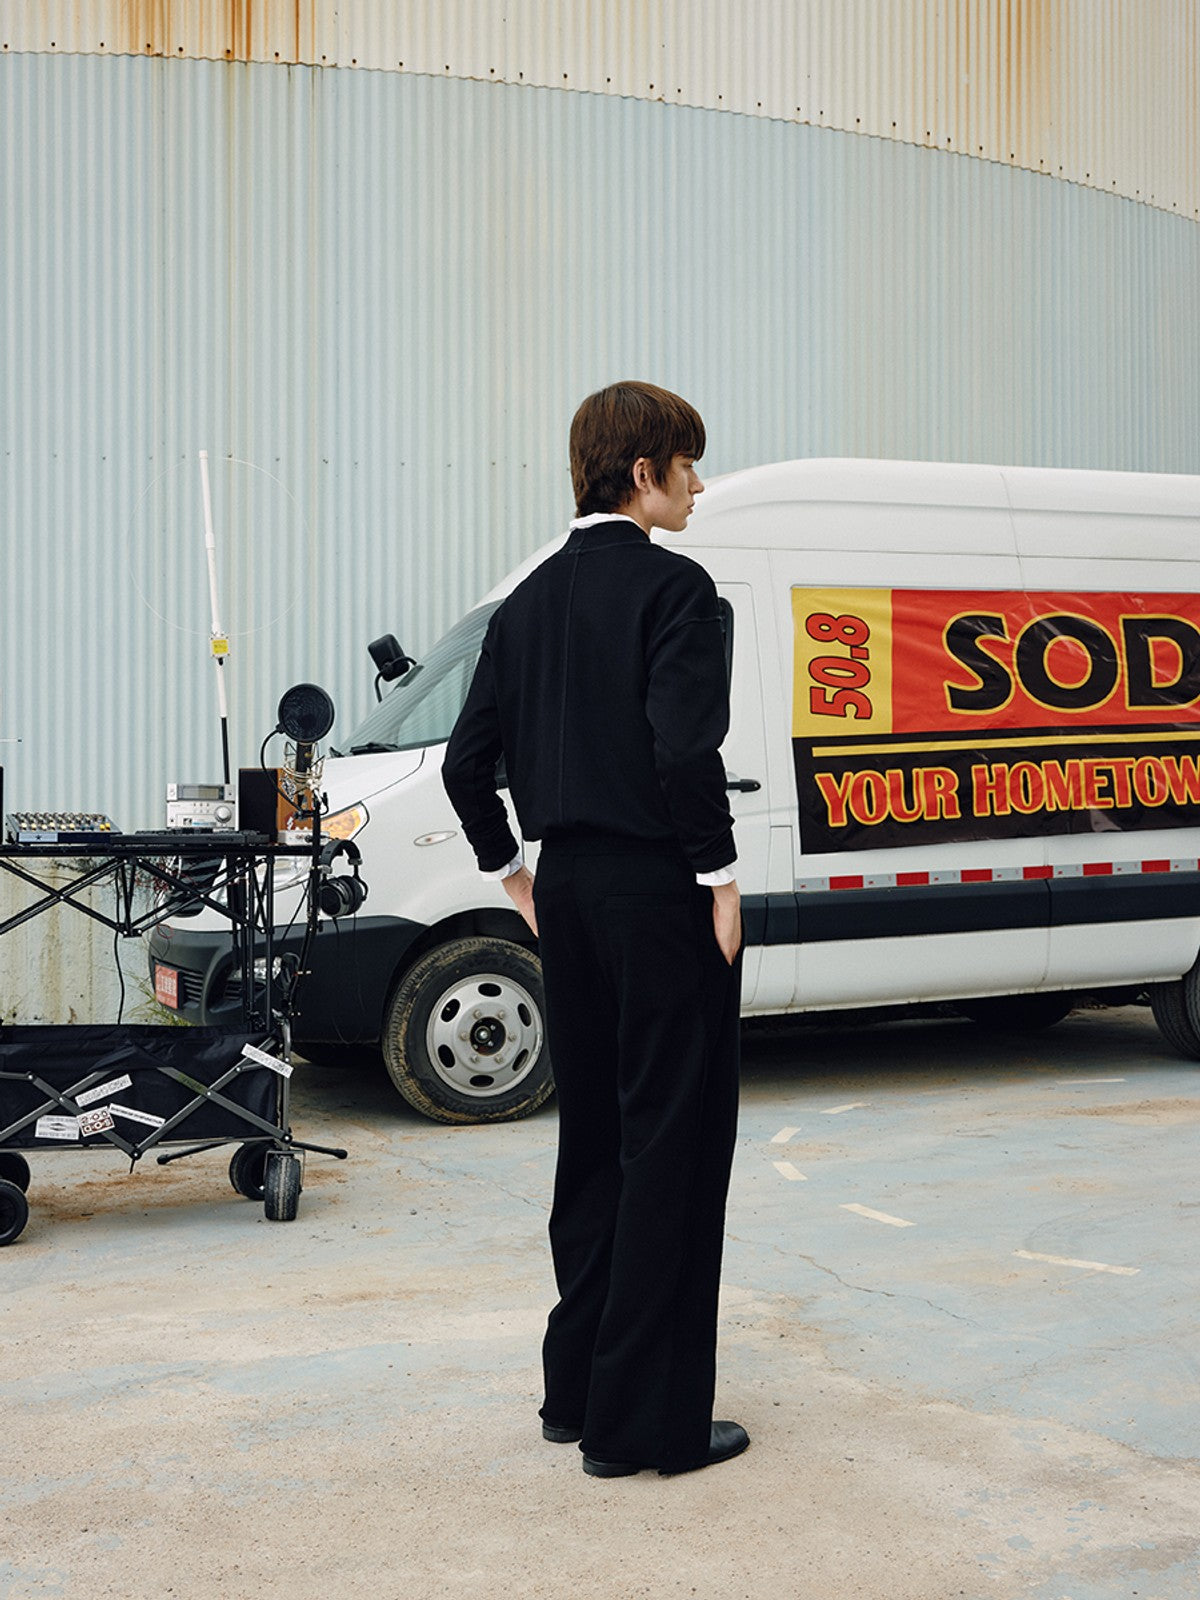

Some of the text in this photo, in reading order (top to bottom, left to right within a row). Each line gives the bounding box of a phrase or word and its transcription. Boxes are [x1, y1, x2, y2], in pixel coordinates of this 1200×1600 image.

[805, 612, 873, 720] 50.8
[942, 611, 1200, 714] SOD
[814, 755, 1200, 827] YOUR HOMETOW
